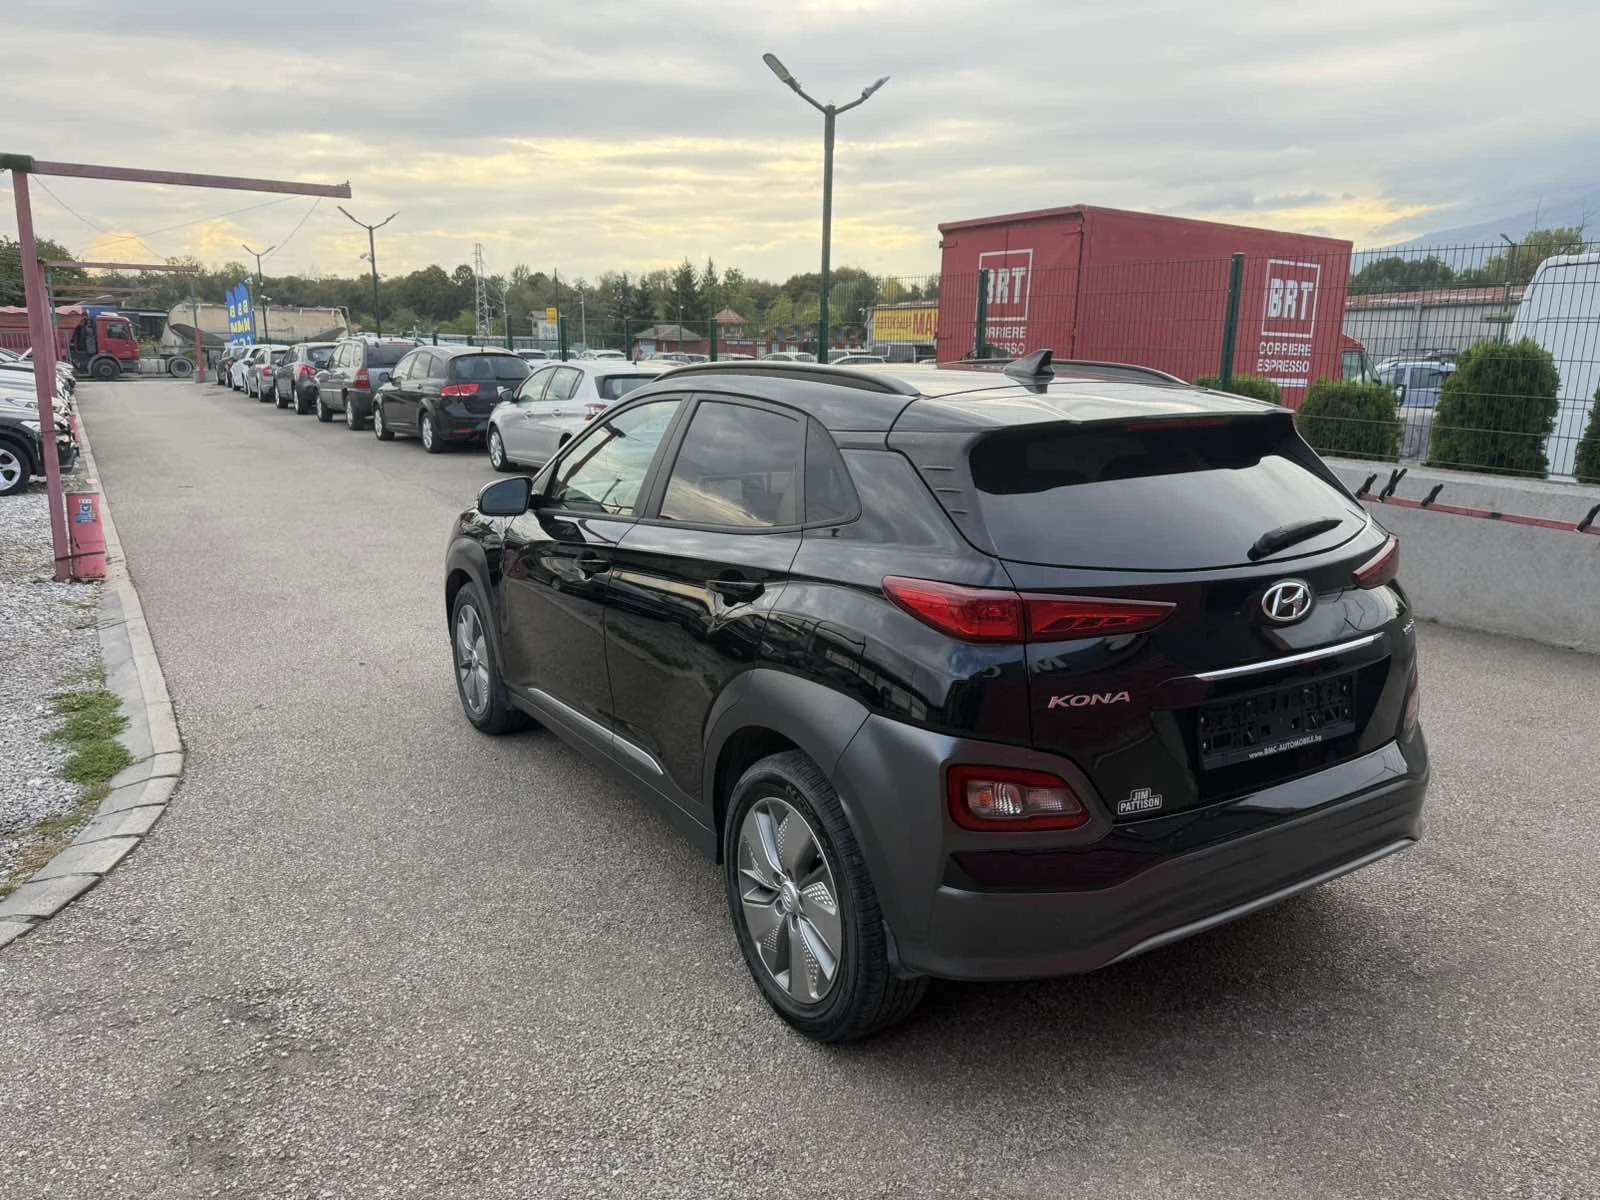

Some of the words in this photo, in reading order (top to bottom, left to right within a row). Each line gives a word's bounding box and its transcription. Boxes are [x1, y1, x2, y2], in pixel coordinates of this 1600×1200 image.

[1267, 278, 1314, 320] BRT
[974, 326, 1027, 339] RRIERE
[1259, 341, 1312, 356] CORRIERE
[1257, 358, 1310, 373] ESPRESSO
[1047, 690, 1131, 709] KONA
[1132, 790, 1149, 801] JIM
[1120, 797, 1160, 812] PATTISON
